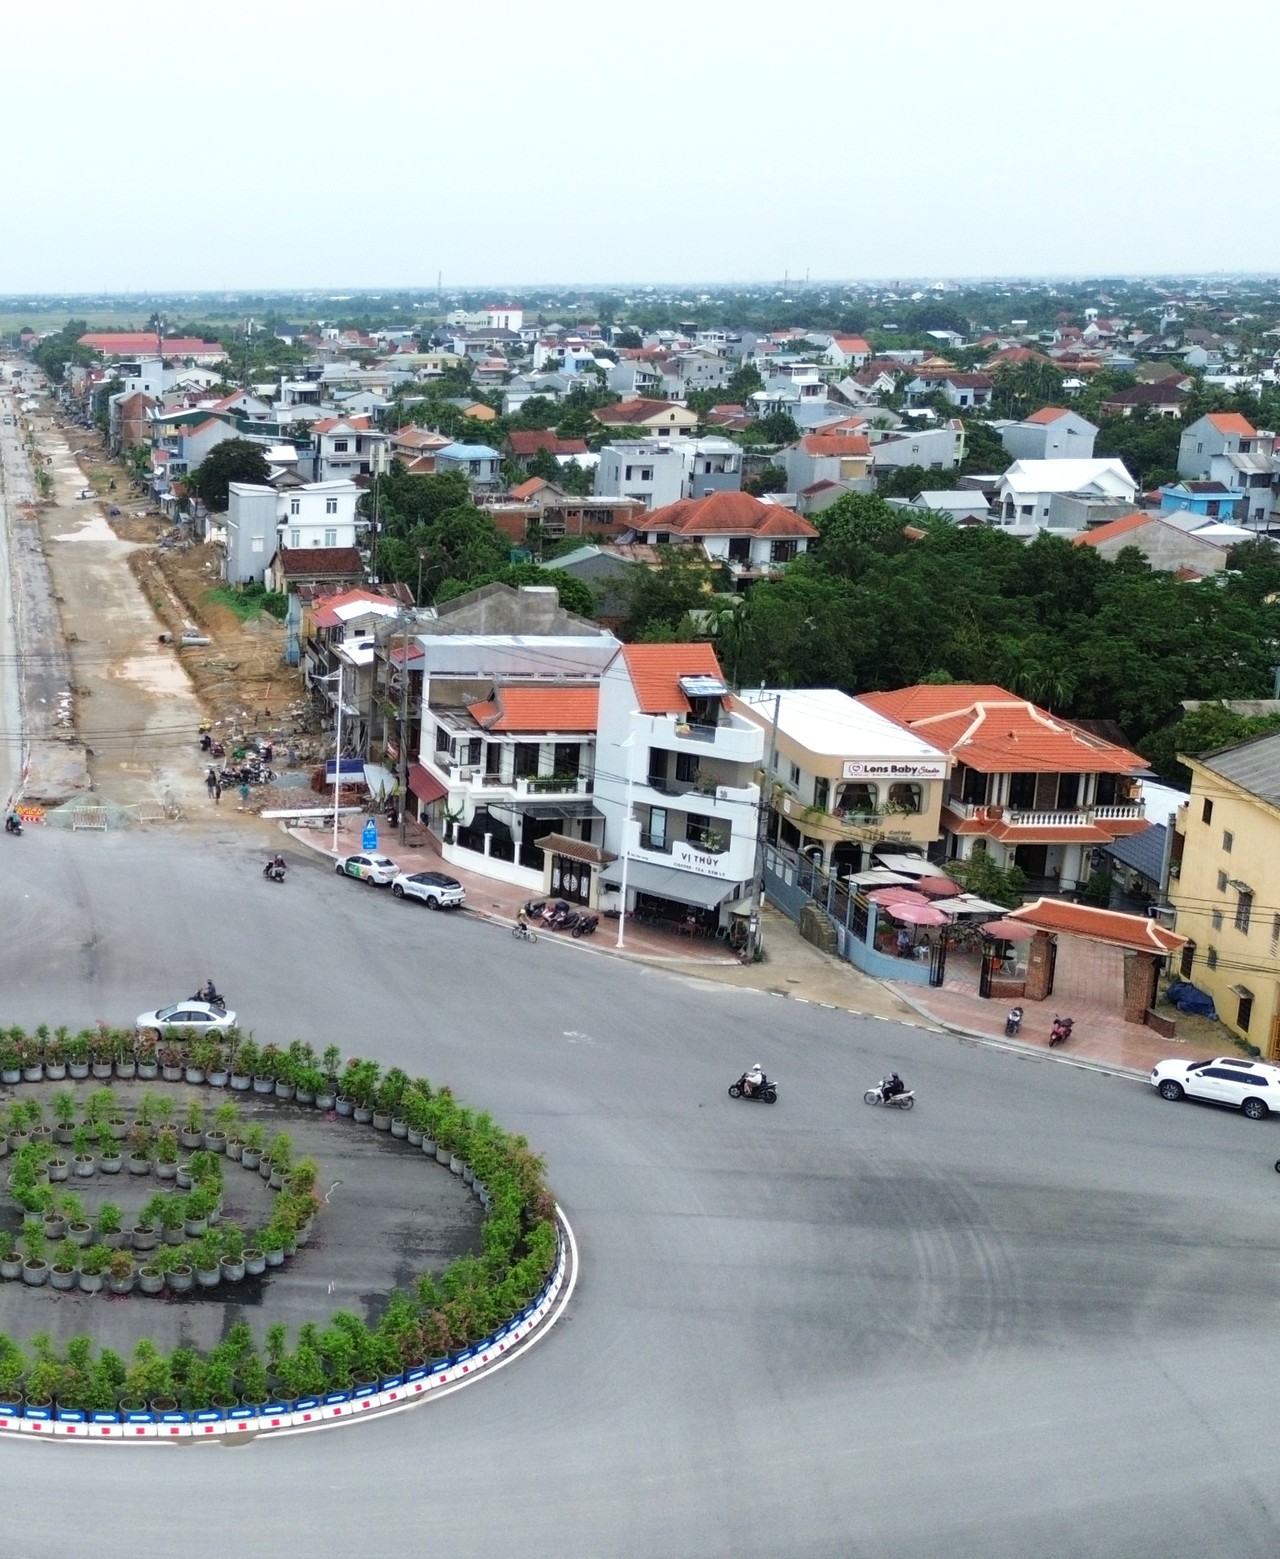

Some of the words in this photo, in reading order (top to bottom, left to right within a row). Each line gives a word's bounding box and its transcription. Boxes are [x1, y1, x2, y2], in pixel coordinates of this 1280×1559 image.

[863, 764, 889, 773] Lens
[891, 764, 918, 774] Baby
[681, 852, 691, 862] VỊ
[694, 855, 719, 867] THỦY
